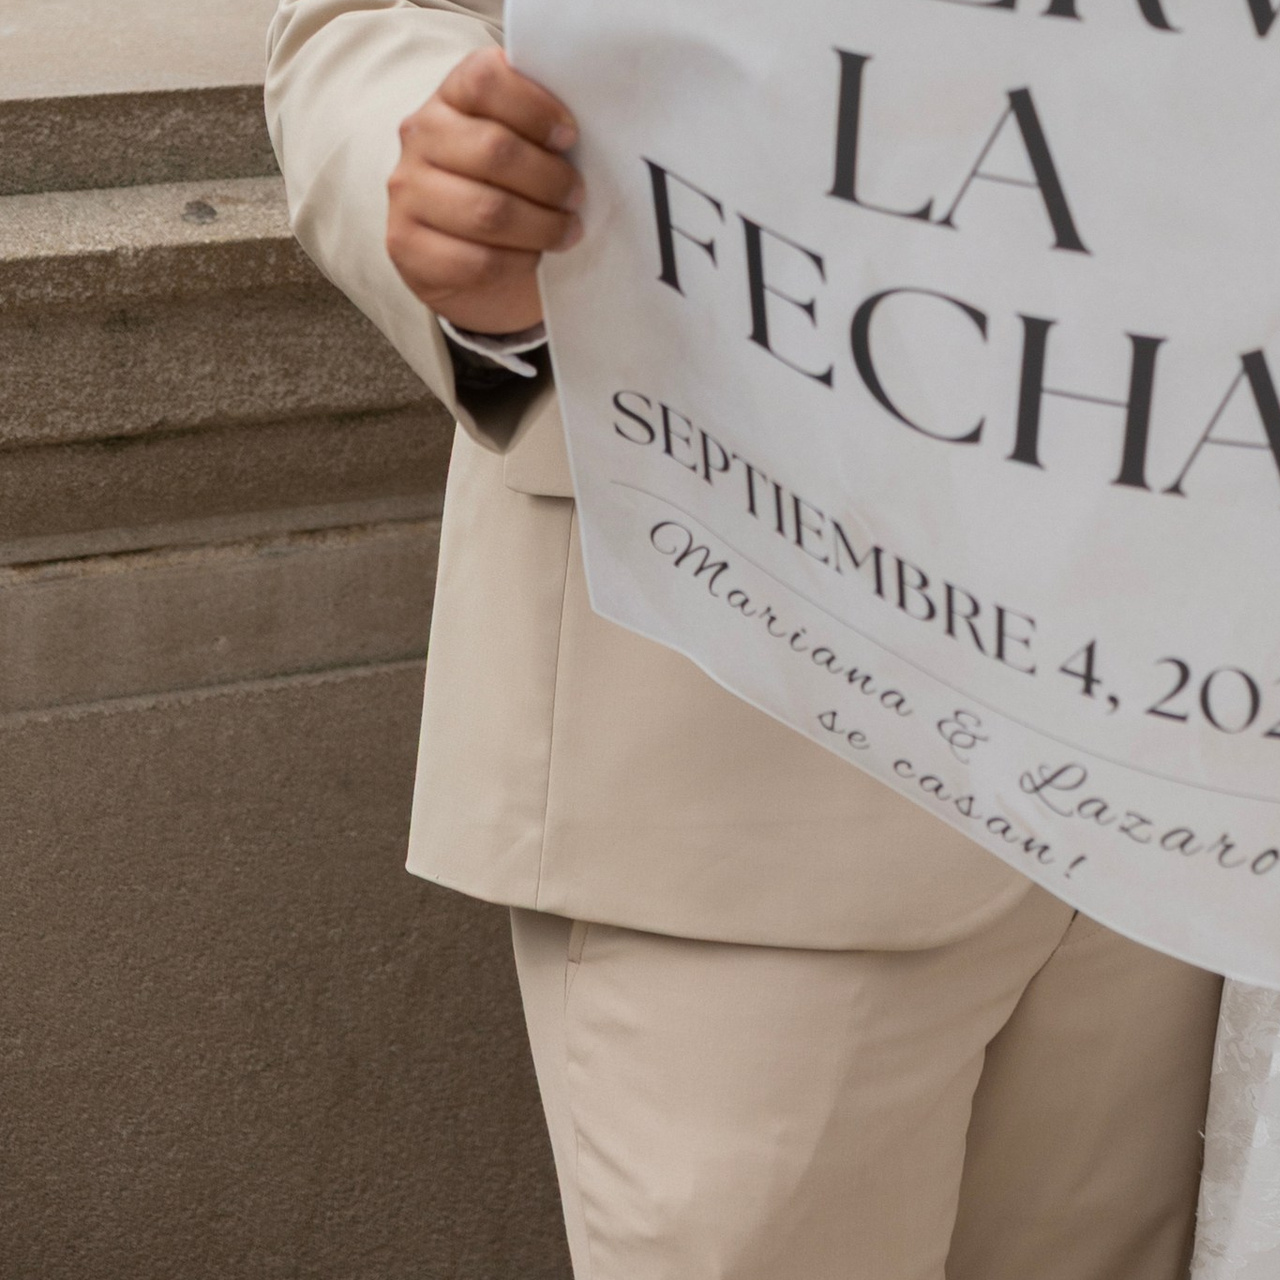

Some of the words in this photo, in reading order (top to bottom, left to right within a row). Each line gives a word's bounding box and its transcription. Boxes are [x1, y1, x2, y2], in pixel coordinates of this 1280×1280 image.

[826, 45, 1093, 256] LA
[611, 389, 1037, 676] SEPTIEMBRE
[1059, 637, 1120, 714] 4,
[649, 520, 913, 717] Mariana
[937, 708, 991, 764] &
[817, 707, 870, 750] se
[893, 756, 1089, 879] casan!
